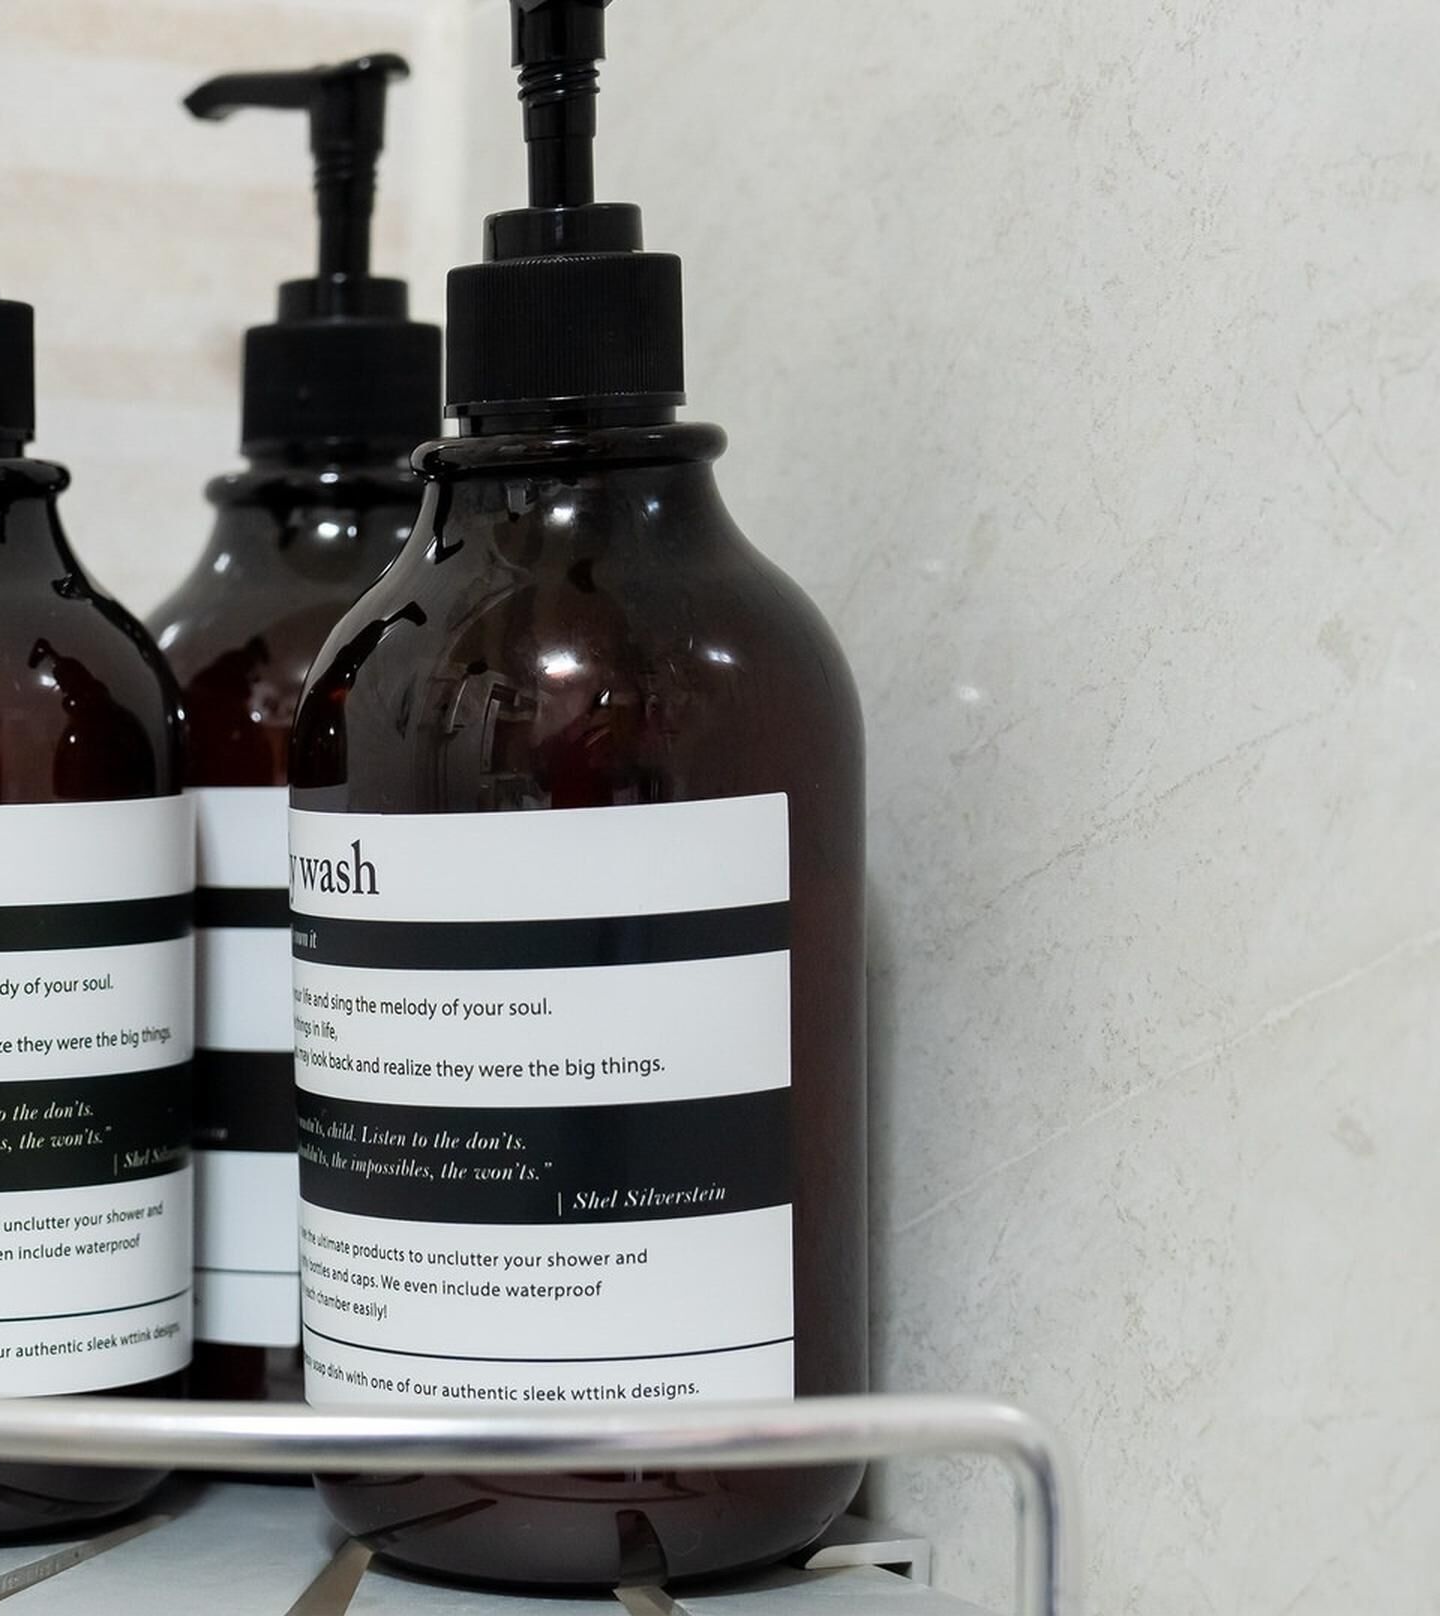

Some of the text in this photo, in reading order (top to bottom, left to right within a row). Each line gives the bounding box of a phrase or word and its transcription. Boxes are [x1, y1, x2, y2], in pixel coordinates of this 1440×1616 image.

[300, 839, 380, 895] wash
[23, 976, 42, 995] of
[43, 979, 80, 999] your
[82, 973, 114, 992] soul.
[314, 992, 329, 1009] and
[331, 993, 353, 1015] sing
[356, 996, 377, 1013] the
[381, 998, 438, 1020] melody
[441, 997, 460, 1017] of
[462, 1002, 505, 1021] your
[508, 997, 553, 1017] soul.
[16, 1035, 54, 1056] they
[56, 1036, 93, 1051] were
[95, 1031, 118, 1048] the
[120, 1029, 140, 1049] big
[329, 1051, 354, 1071] back
[356, 1056, 380, 1073] and
[383, 1058, 432, 1076] realize
[435, 1059, 475, 1083] they
[477, 1064, 524, 1078] were
[527, 1058, 560, 1078] the
[564, 1058, 596, 1081] big
[600, 1056, 666, 1078] things.
[12, 1103, 39, 1122] the
[19, 1131, 46, 1150] the
[361, 1125, 406, 1147] Listen
[411, 1131, 428, 1148] to
[433, 1130, 461, 1149] the
[331, 1151, 348, 1169] the
[350, 1153, 435, 1180] impossibles,
[440, 1160, 468, 1180] the
[572, 1182, 726, 1210] Shel Silverstein
[3, 1216, 71, 1233] unclutter
[73, 1214, 104, 1232] your
[106, 1208, 145, 1225] shower
[146, 1203, 163, 1218] and
[18, 1242, 72, 1260] include
[74, 1233, 141, 1256] waterproof
[352, 1243, 405, 1262] products
[409, 1248, 424, 1264] to
[427, 1250, 499, 1268] unclutter
[503, 1255, 543, 1272] your
[547, 1251, 611, 1268] shower
[615, 1247, 648, 1266] and
[332, 1267, 349, 1284] and
[380, 1274, 400, 1292] We
[403, 1280, 438, 1295] even
[441, 1279, 501, 1298] include
[504, 1279, 603, 1302] waterproof
[15, 1339, 84, 1358] authentic
[86, 1334, 118, 1352] sleek
[346, 1368, 369, 1388] with
[371, 1377, 394, 1392] one
[396, 1378, 411, 1393] of
[413, 1383, 438, 1397] our
[441, 1383, 518, 1401] authentic
[522, 1385, 567, 1402] sleek
[630, 1381, 700, 1401] designs.
